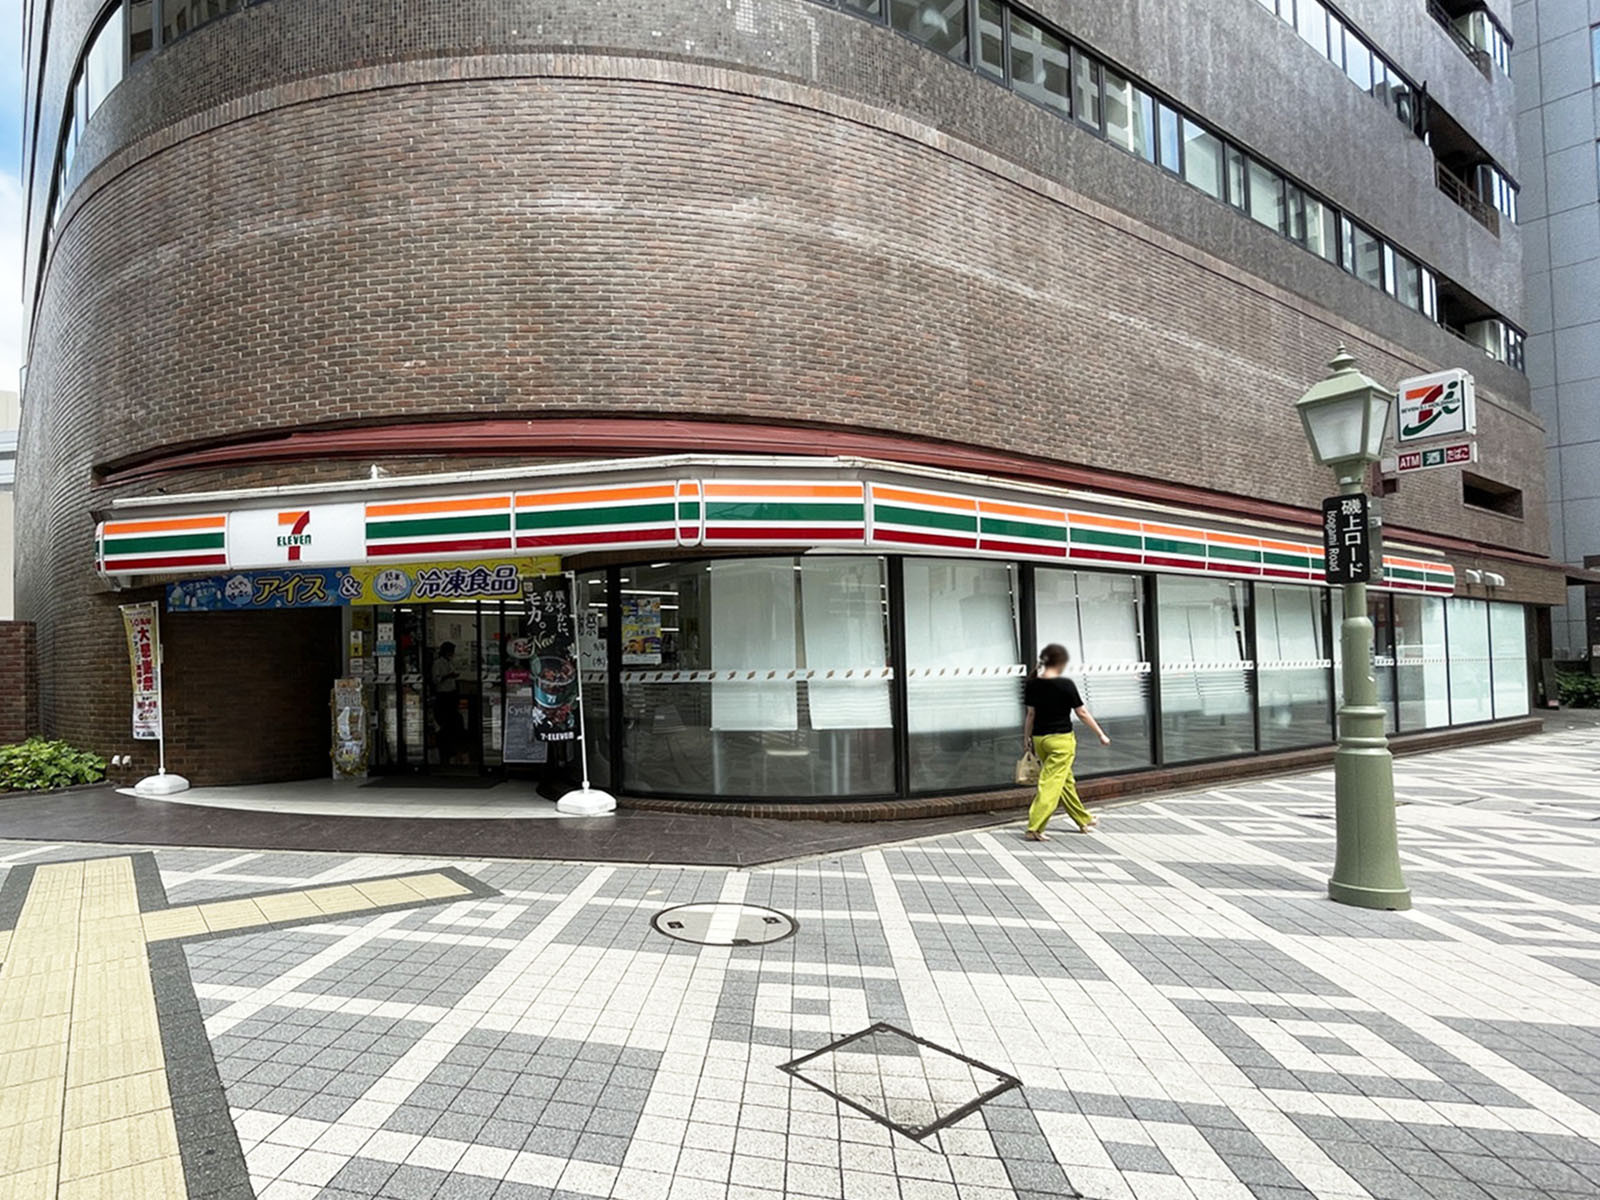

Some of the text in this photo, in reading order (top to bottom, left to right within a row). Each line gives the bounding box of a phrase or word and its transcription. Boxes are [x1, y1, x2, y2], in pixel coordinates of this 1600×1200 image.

[1400, 455, 1420, 468] ATM
[1447, 447, 1468, 461] たばこ
[1325, 510, 1340, 572] Isogami Road
[1341, 499, 1363, 578] 磯上ロード
[254, 575, 327, 605] アイス
[341, 577, 361, 597] &
[416, 566, 519, 597] 冷凍食品
[526, 592, 547, 630] モカ。
